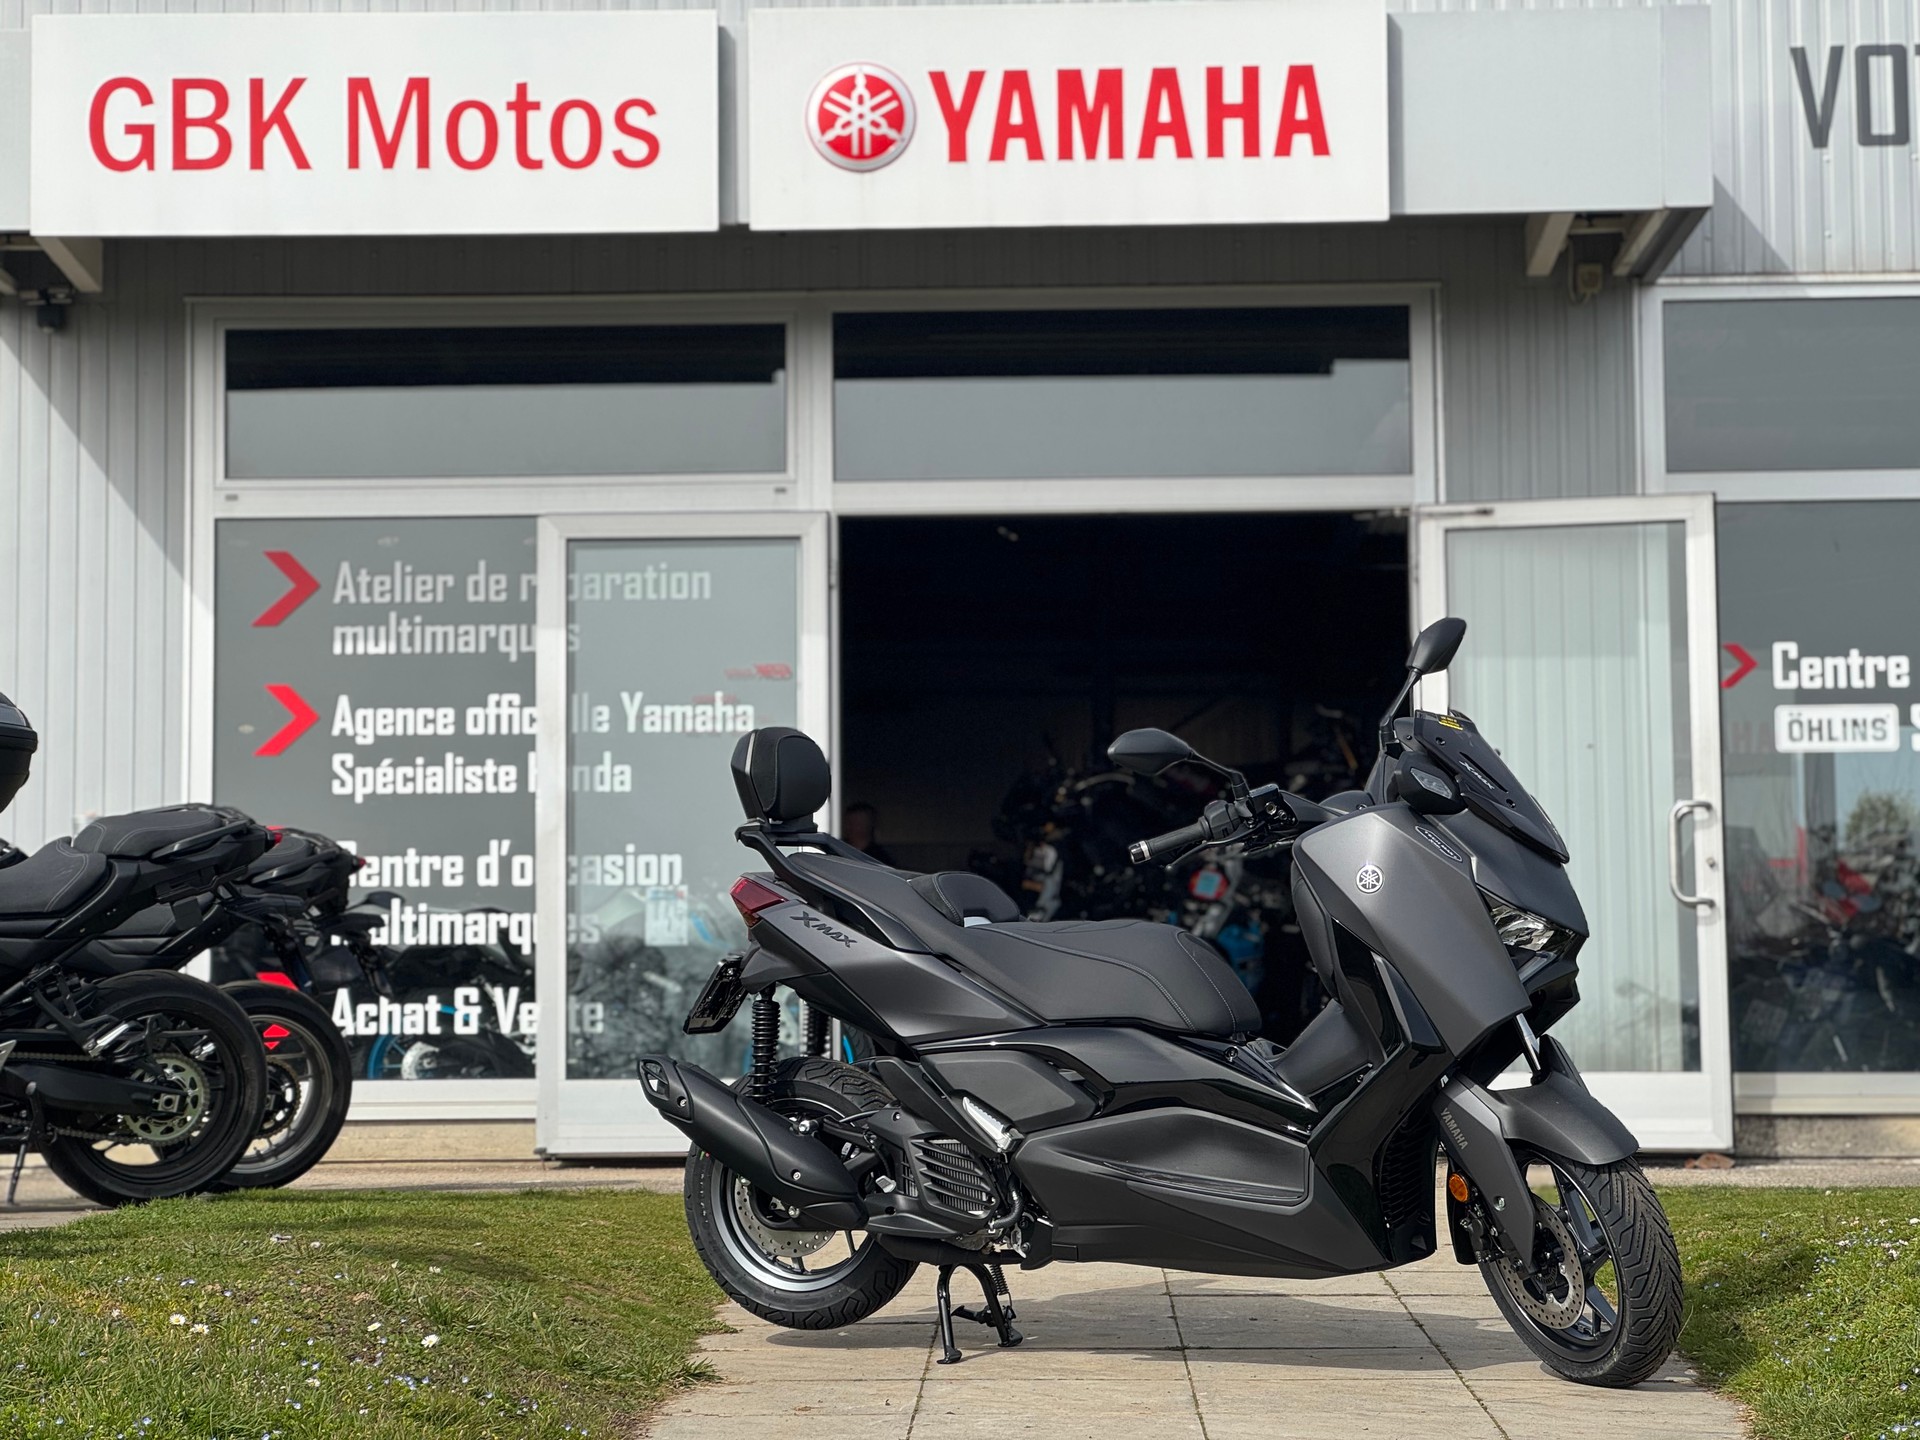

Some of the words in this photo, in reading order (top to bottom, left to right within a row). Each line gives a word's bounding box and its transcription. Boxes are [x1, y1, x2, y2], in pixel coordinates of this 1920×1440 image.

[928, 64, 1330, 163] YAMAHA
[1789, 43, 1920, 149] VO
[89, 77, 312, 172] GBK
[347, 76, 661, 171] Motos
[333, 560, 455, 604] Atelier
[466, 559, 507, 602] de
[520, 560, 711, 601] raration
[332, 611, 581, 662] multimarqus
[1772, 641, 1911, 690] Centre
[331, 694, 456, 746] Agence
[465, 692, 611, 736] officlle
[620, 690, 755, 735] Yamaha
[1787, 711, 1888, 743] ÖHLINS
[331, 751, 518, 805] Spécialiste
[789, 910, 858, 949] XMAX
[331, 987, 442, 1037] Achat
[453, 986, 482, 1035] &
[493, 986, 605, 1035] Vete
[1441, 1107, 1469, 1150] YAMAHA
